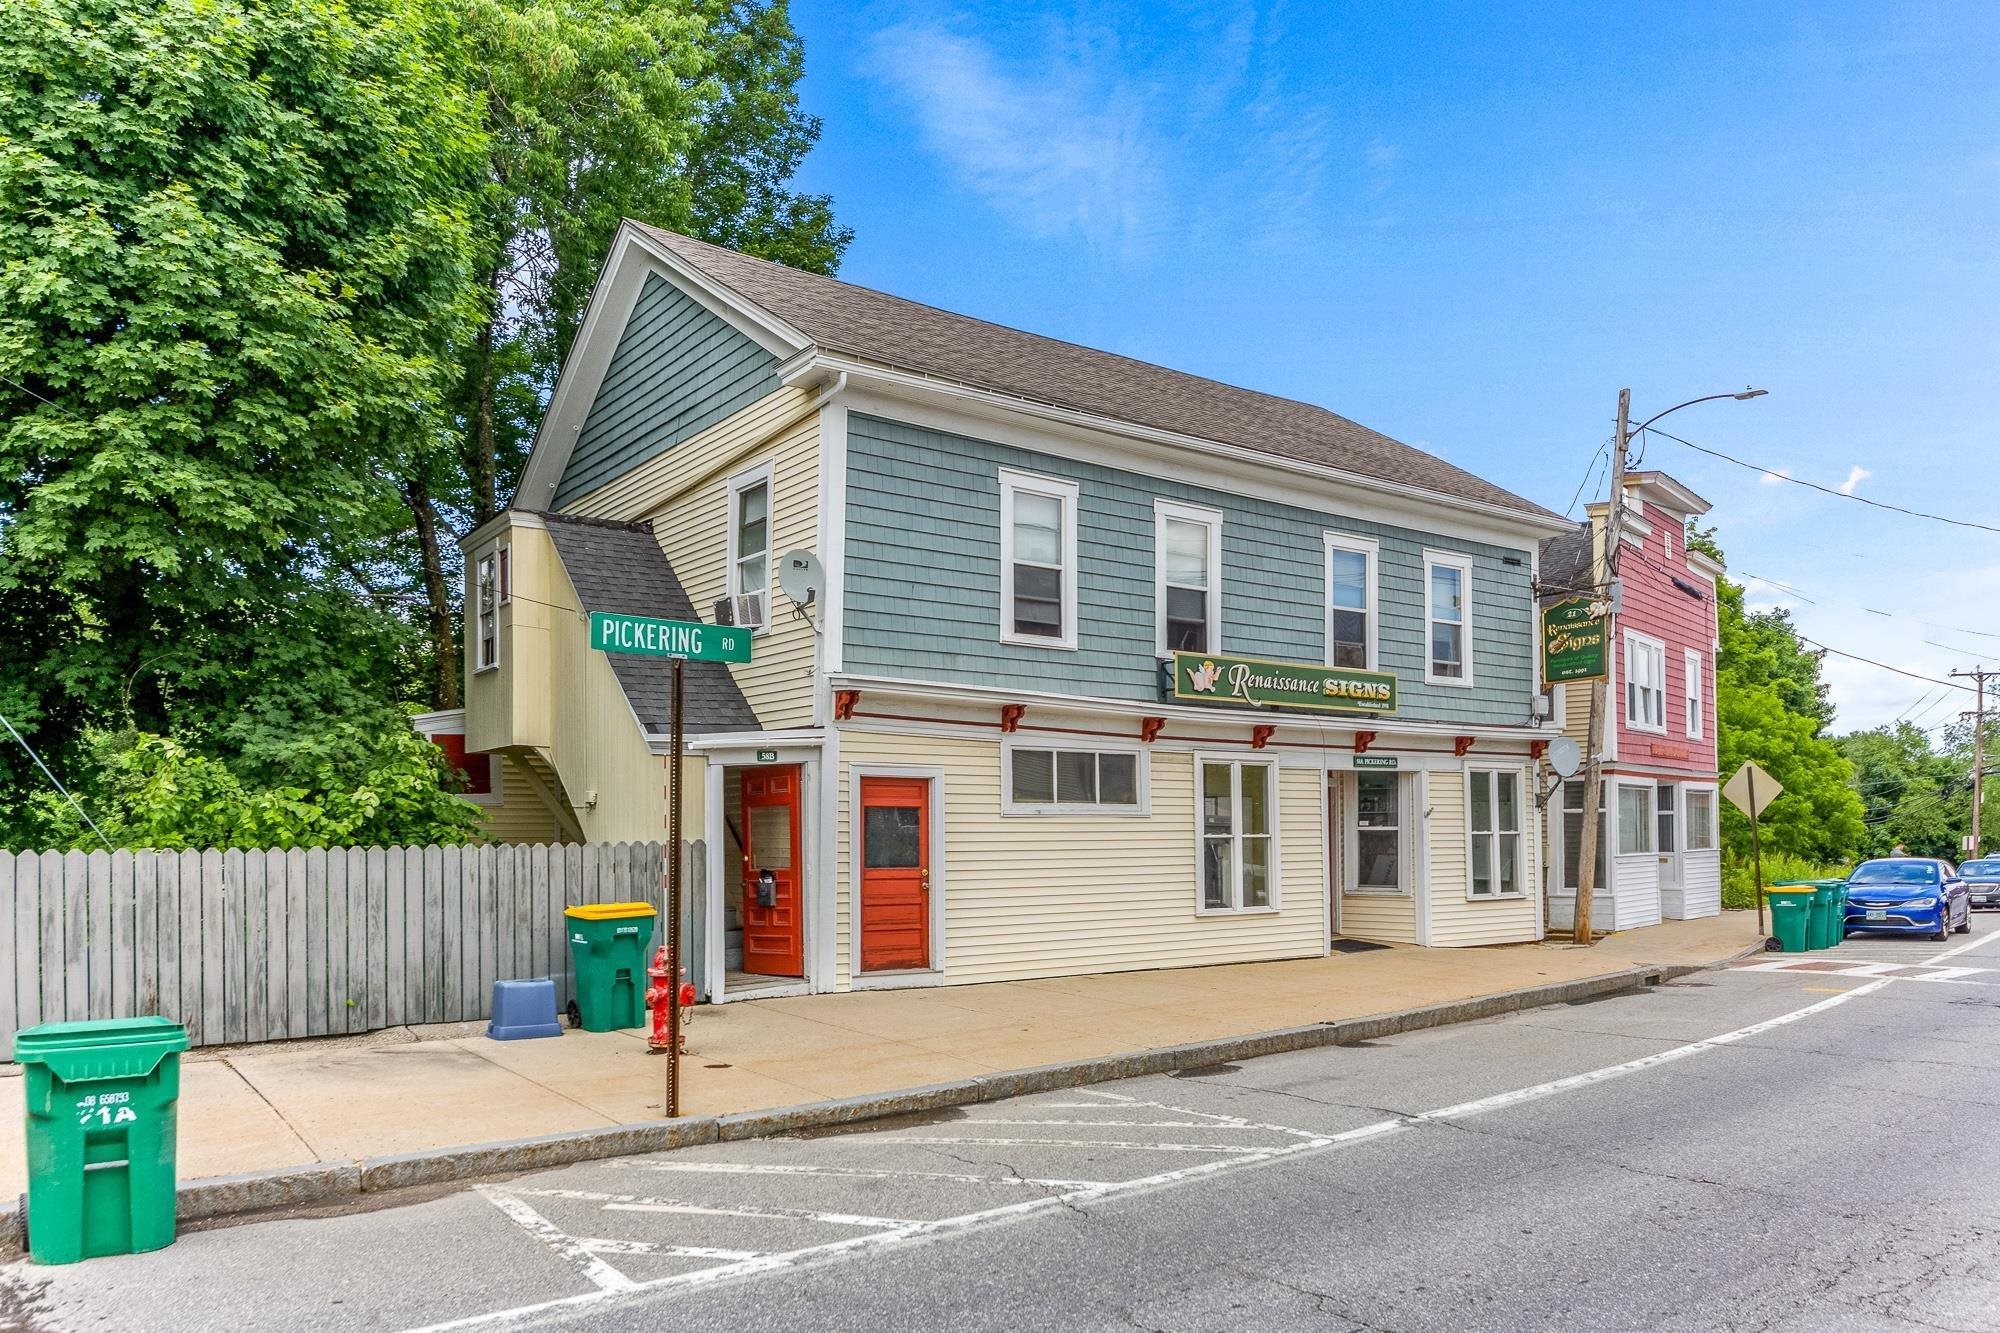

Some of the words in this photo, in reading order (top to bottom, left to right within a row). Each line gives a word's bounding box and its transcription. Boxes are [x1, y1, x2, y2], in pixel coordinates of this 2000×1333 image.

[602, 619, 702, 654] PICKERING
[722, 637, 735, 651] RD
[1228, 664, 1319, 707] Renaissance
[1323, 678, 1391, 700] SIGNS
[761, 752, 775, 760] 58B
